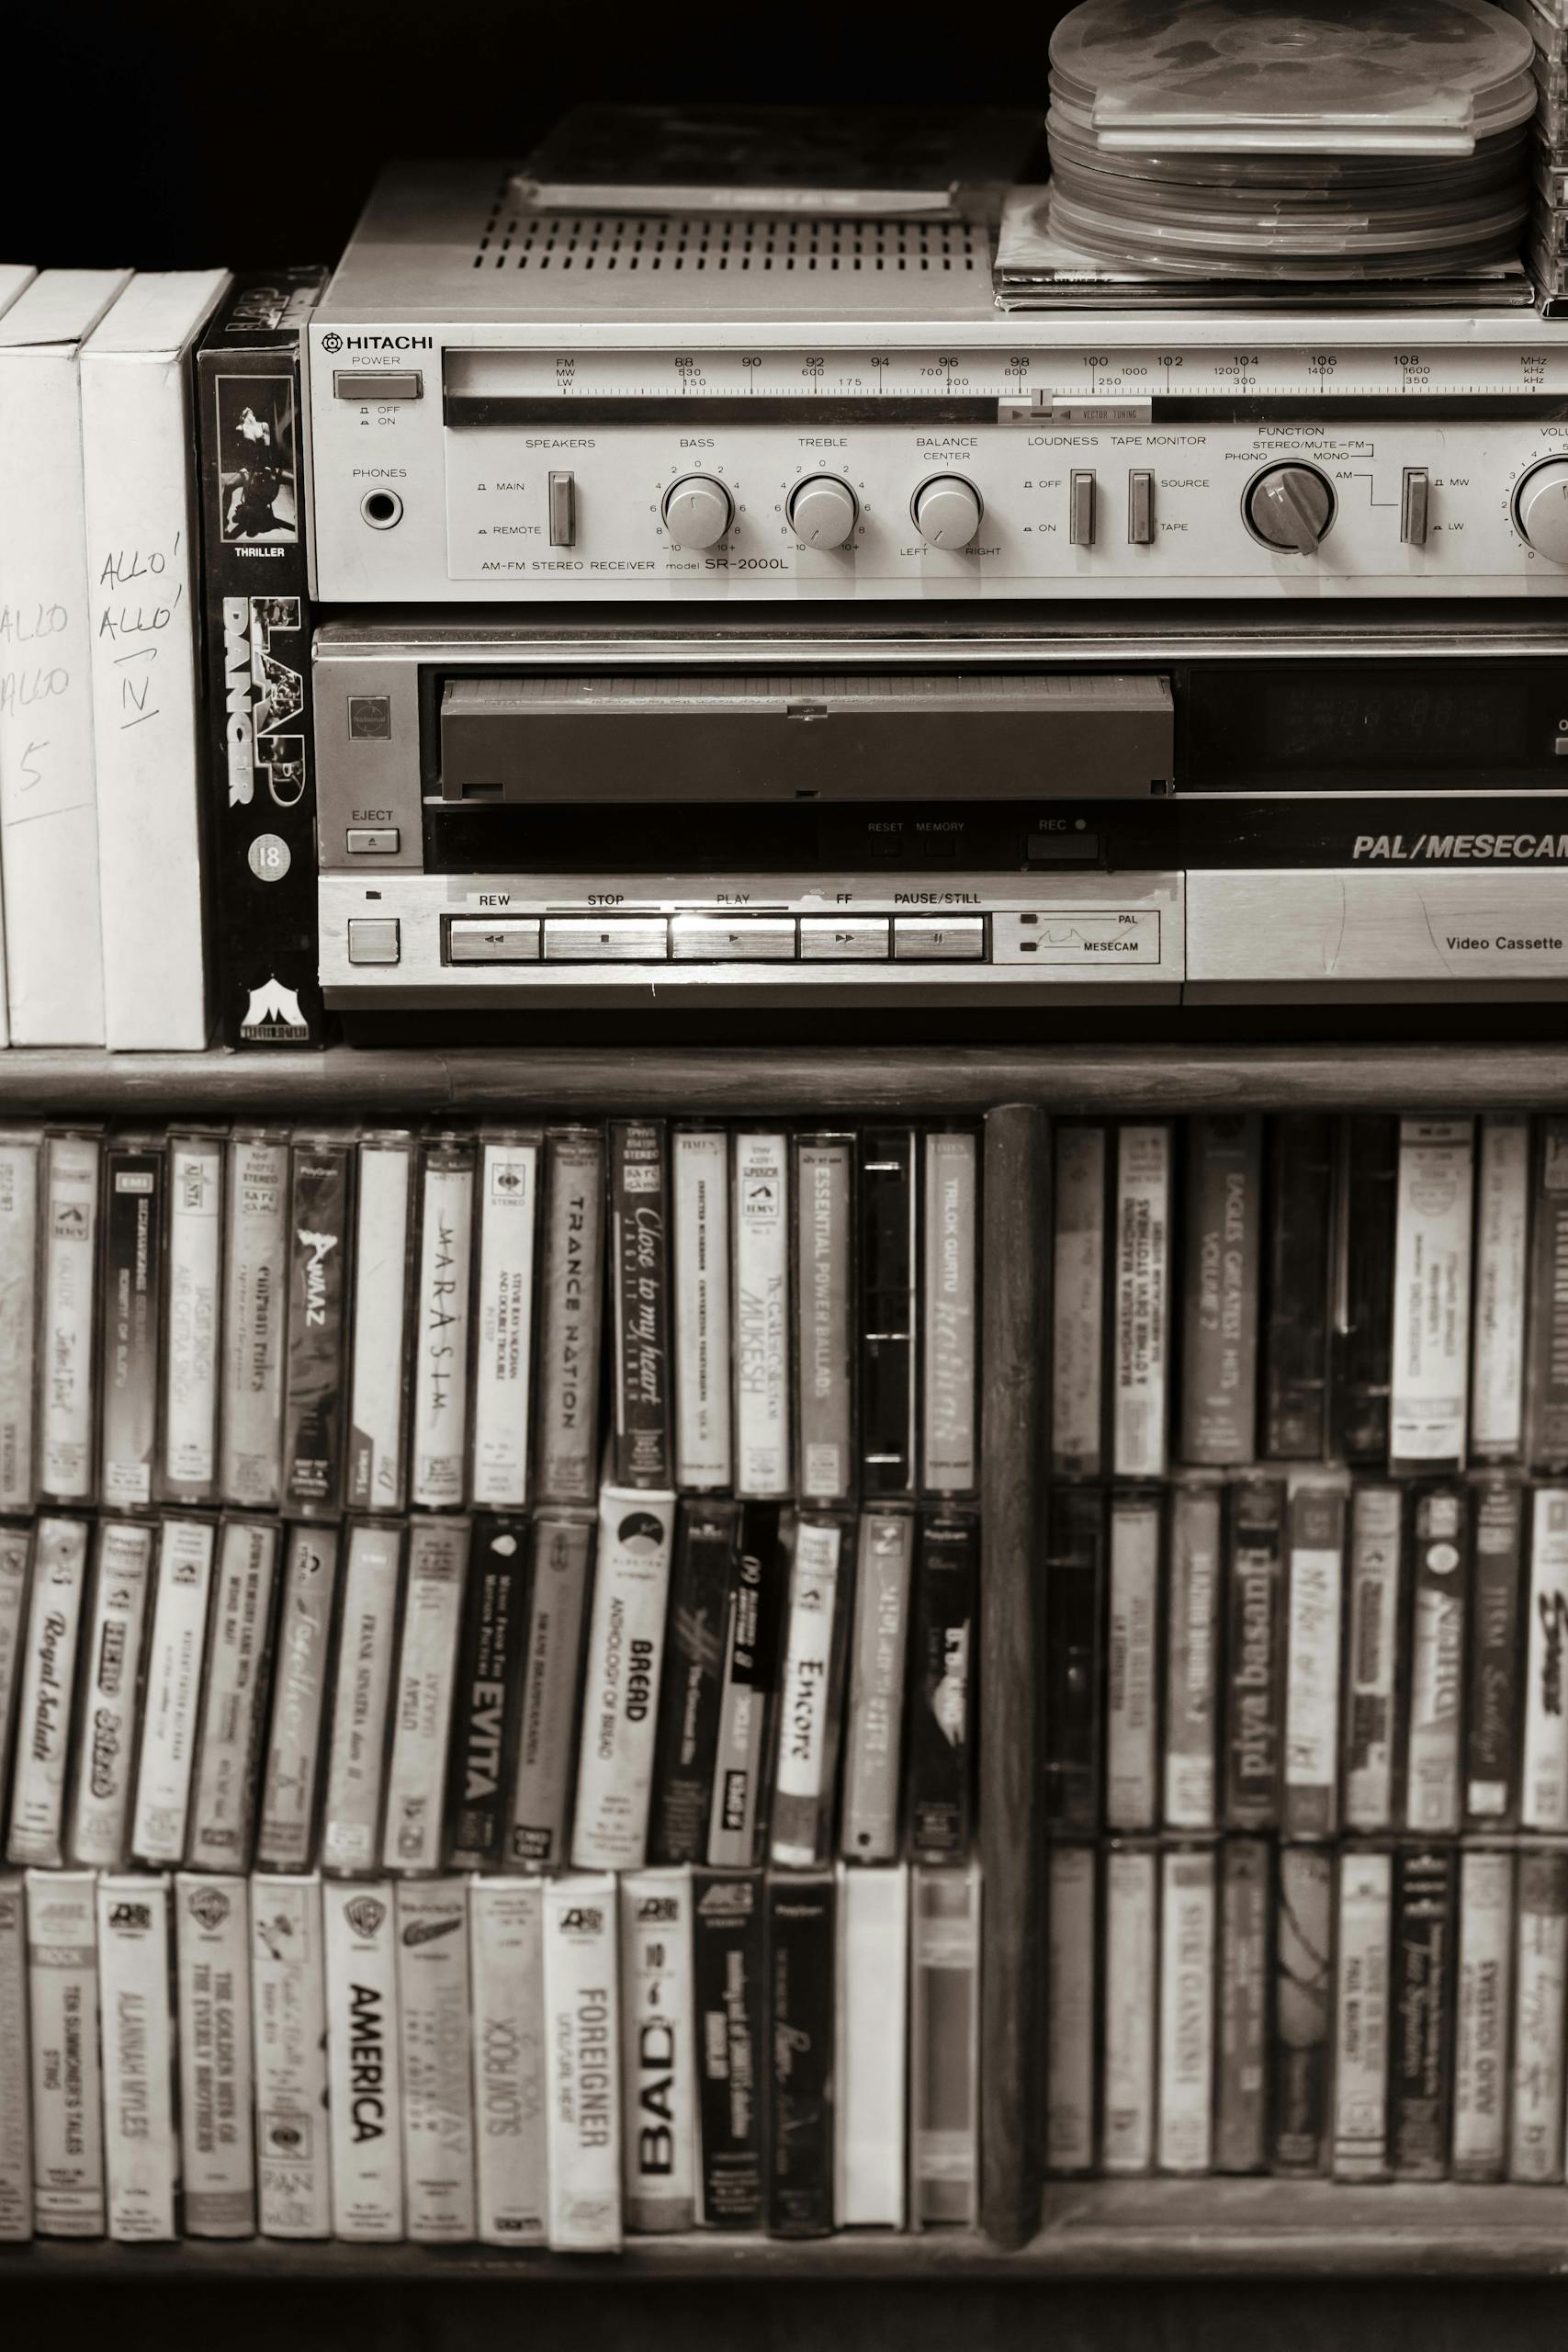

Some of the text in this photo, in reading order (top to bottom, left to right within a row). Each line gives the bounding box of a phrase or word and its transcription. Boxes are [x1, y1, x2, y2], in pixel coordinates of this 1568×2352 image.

[346, 336, 433, 349] HITACHI
[352, 356, 400, 366] POWER
[674, 357, 694, 368] 88
[742, 357, 761, 367] 90
[806, 356, 824, 367] 92
[871, 357, 890, 367] 94
[939, 356, 959, 367] 96
[1010, 356, 1030, 367] 98
[1083, 356, 1108, 367] 100
[1157, 356, 1183, 367] 102
[1234, 356, 1258, 366] 104
[1312, 356, 1337, 366] 106
[1393, 356, 1419, 365] 108
[1520, 356, 1547, 365] MHz
[1083, 411, 1136, 419] VECTOR TUNING
[1258, 427, 1324, 435] FUNCTION
[525, 439, 595, 447] SPEAKERS
[680, 438, 715, 447] BASS
[798, 438, 848, 447] TREBLE
[917, 438, 977, 447] BALANCE
[1028, 437, 1099, 446] LOUDNESS
[1111, 436, 1206, 445] TAPE MONITOR
[235, 548, 285, 557] THRILLER
[481, 561, 525, 570] AM-FM
[532, 561, 583, 570] STEREO
[590, 561, 655, 570] RECEIVER
[705, 559, 789, 569] SR-2000L
[223, 596, 254, 808] DANCER
[250, 596, 307, 808] LAP
[20, 741, 50, 792] 5
[352, 810, 393, 821] EJECT
[868, 823, 964, 831] RESET MEMORY
[1039, 820, 1066, 831] REC
[258, 846, 280, 867] 18
[479, 895, 510, 906] REW
[588, 895, 625, 905] STOP
[716, 894, 750, 905] PLAY
[836, 894, 852, 904] FF
[895, 893, 981, 904] PAUSE/STILL
[1118, 915, 1137, 923] PAL
[1084, 943, 1138, 951] MESECAM
[1447, 937, 1562, 950] Video Cassette
[814, 1167, 831, 1258] ESSENTIAL
[637, 1207, 663, 1269] Close
[943, 1178, 959, 1292] TRILOK GURTU
[638, 1277, 661, 1298] to
[814, 1262, 829, 1321] POWER
[562, 1196, 585, 1430] TRANCE NATION
[628, 1305, 659, 1343] my
[739, 1288, 765, 1394] MUKESH
[814, 1326, 830, 1397] BALLADS
[638, 1346, 664, 1405] heart
[604, 1598, 625, 1687] ANTHOLOGY
[32, 1611, 66, 1762] Royal Salute
[626, 1640, 654, 1723] BREAD
[792, 1659, 824, 1761] Encore
[464, 1680, 506, 1800] EVITA
[118, 1992, 149, 2140] ALANNAH MYLES
[350, 1984, 385, 2143] AMERICA
[577, 1989, 608, 2148] FOREIGNER
[639, 2023, 675, 2176] BAD
